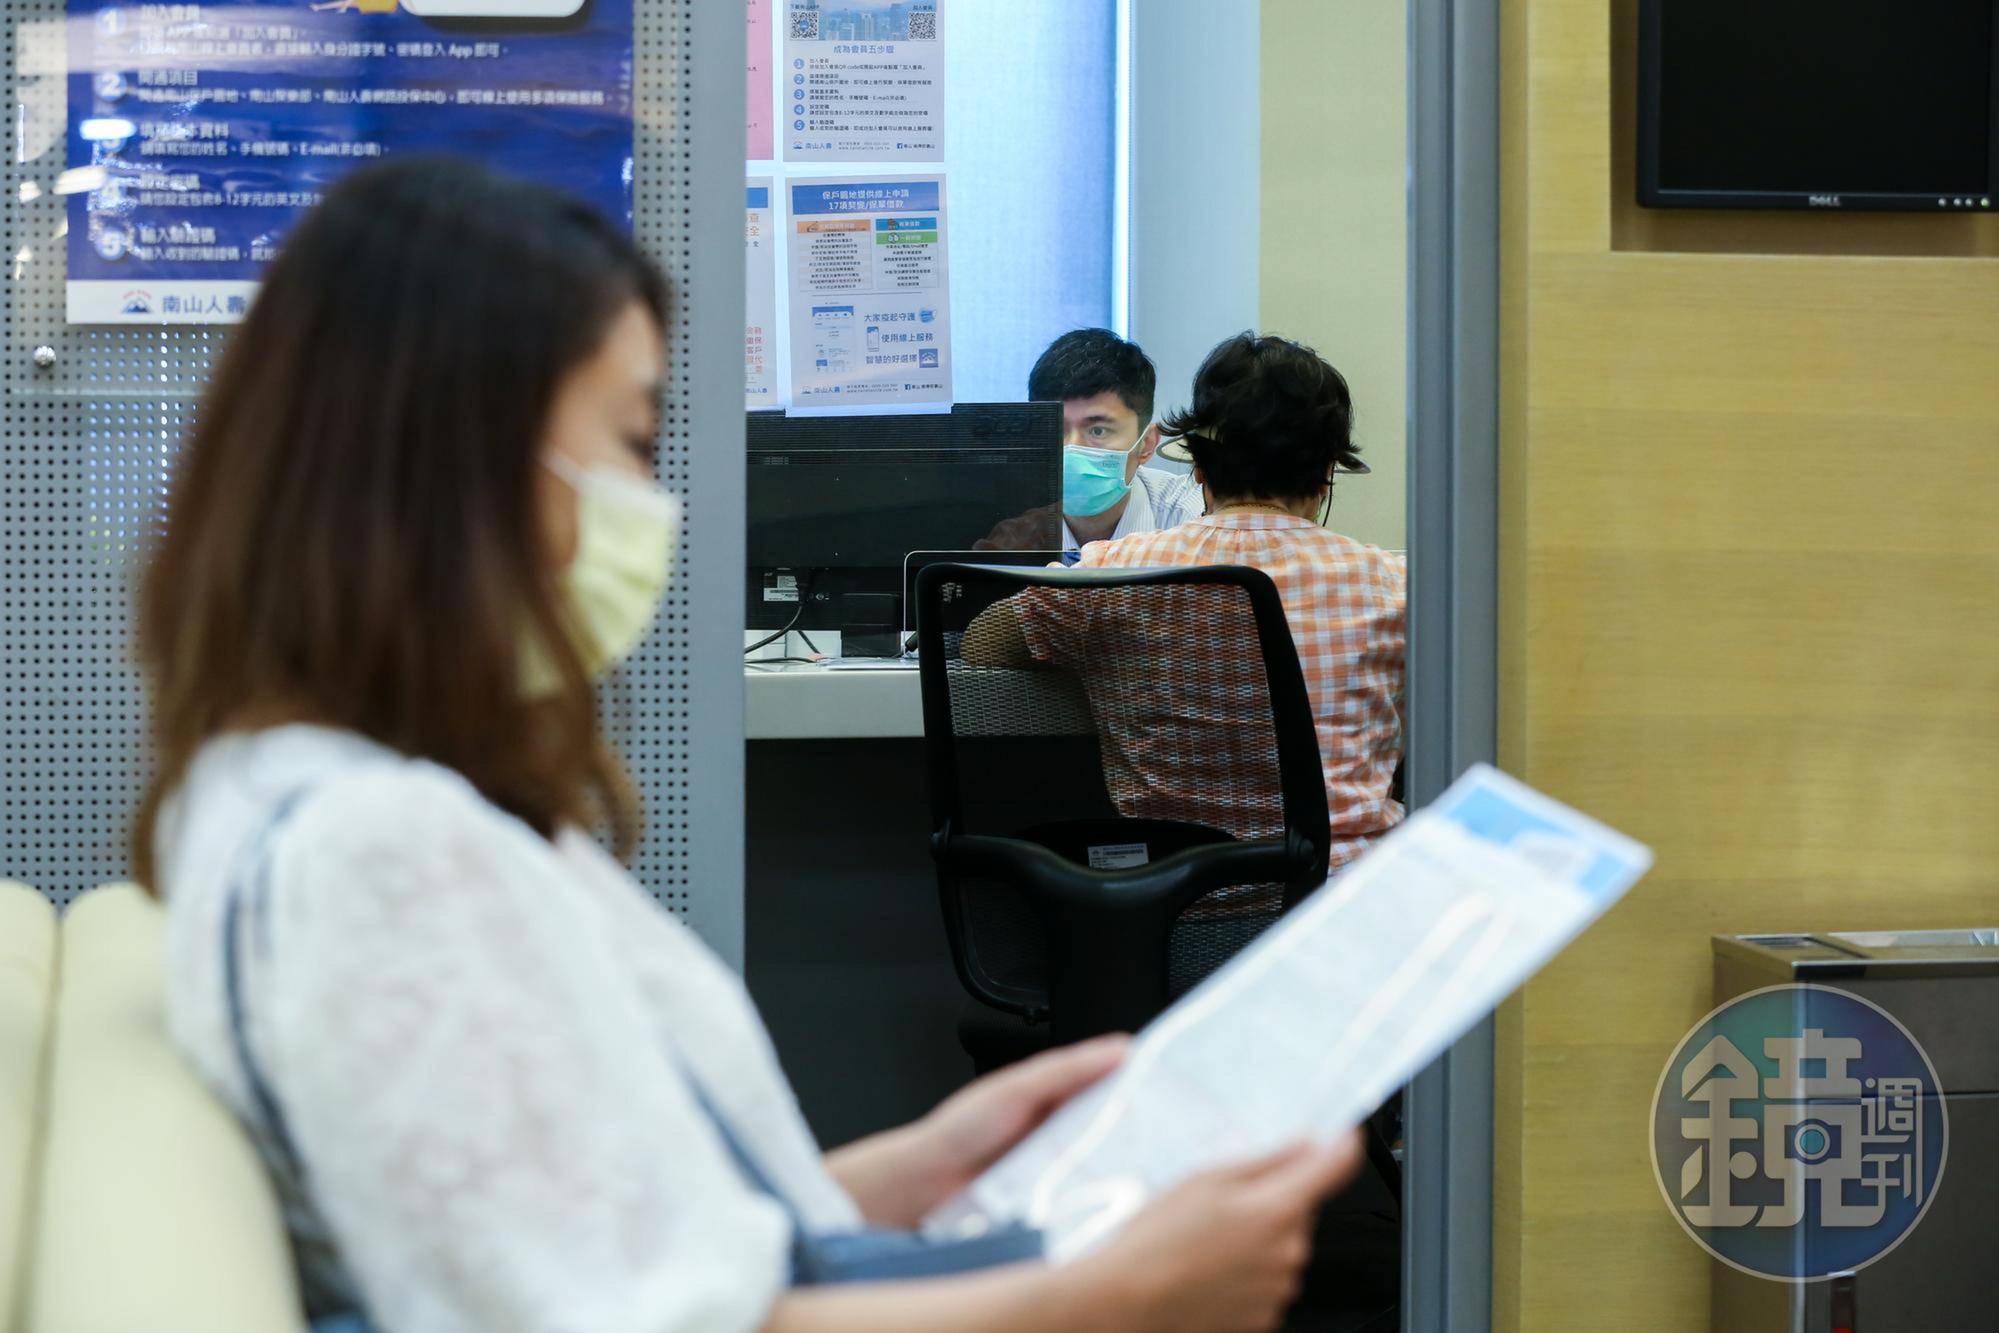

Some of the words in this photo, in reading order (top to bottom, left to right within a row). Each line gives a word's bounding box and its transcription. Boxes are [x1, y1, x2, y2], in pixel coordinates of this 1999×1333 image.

[833, 45, 895, 54] 成為會員五步驟
[822, 189, 909, 200] 保戶園地提供線上申請
[881, 333, 934, 343] 使用線上服務
[865, 353, 918, 364] 智慧的好選擇
